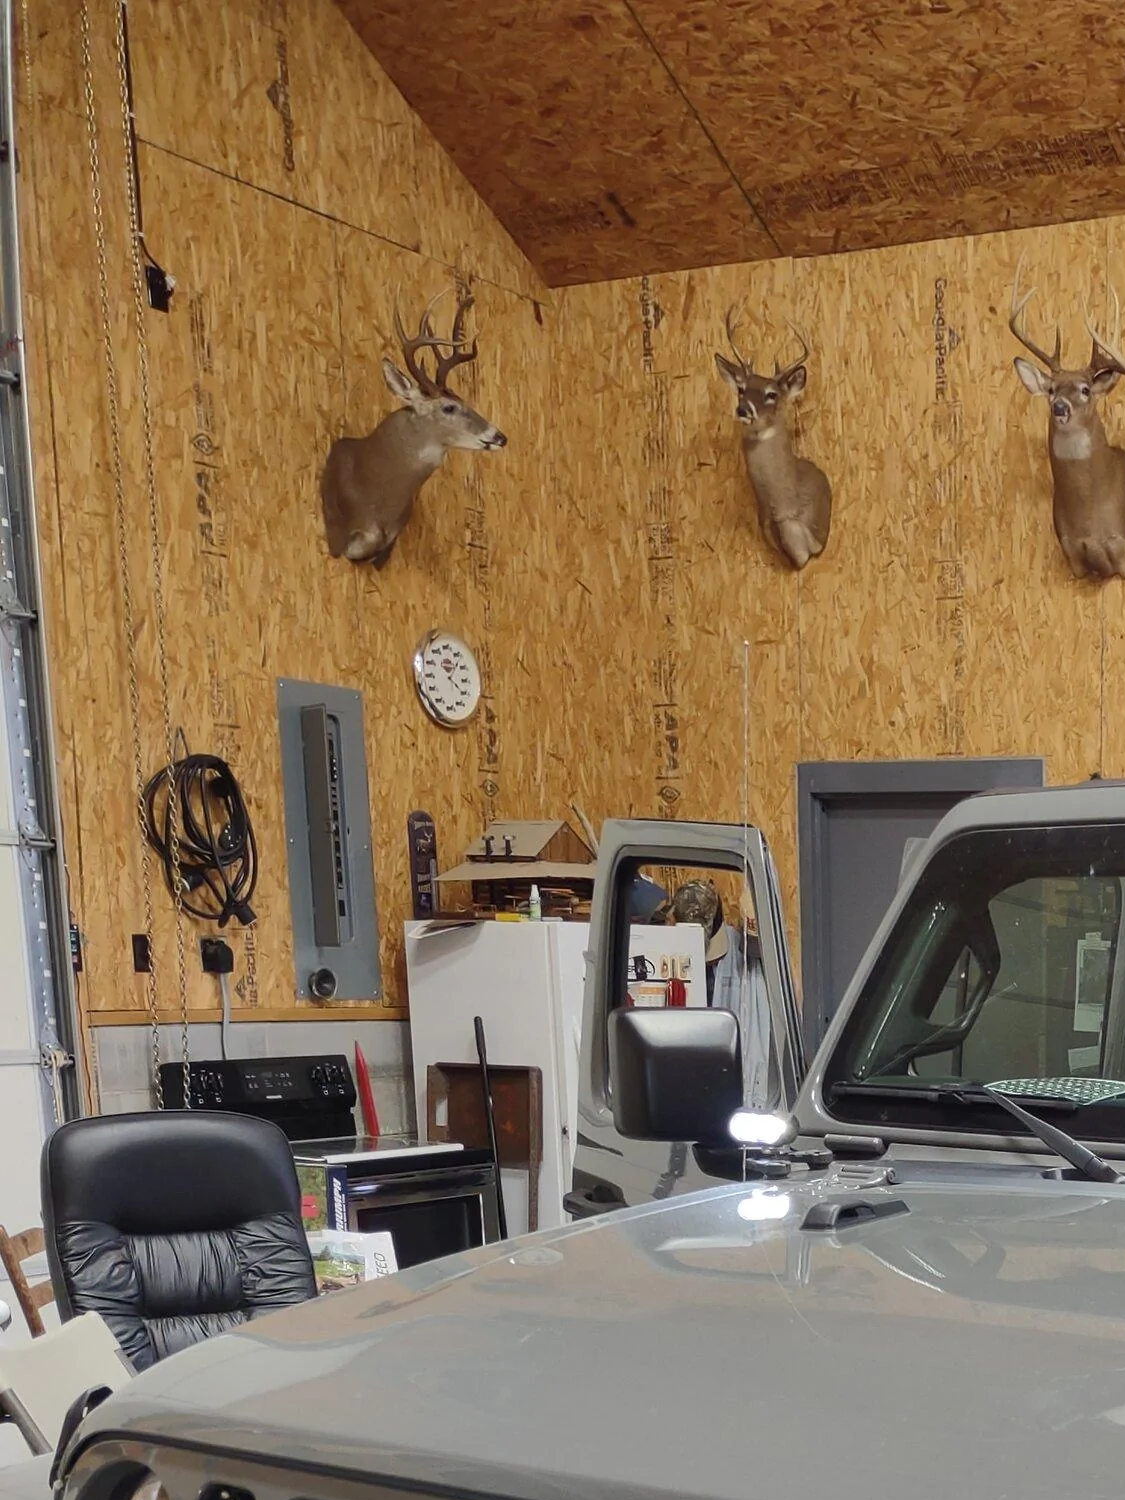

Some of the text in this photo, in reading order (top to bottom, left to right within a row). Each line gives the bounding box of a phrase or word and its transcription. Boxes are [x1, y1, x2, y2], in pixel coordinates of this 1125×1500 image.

[639, 276, 653, 372] orgia-Pacific
[932, 276, 948, 401] Georgia-Pacific
[195, 471, 217, 547] APA
[665, 709, 679, 770] APA
[332, 1177, 343, 1231] RIUMPH
